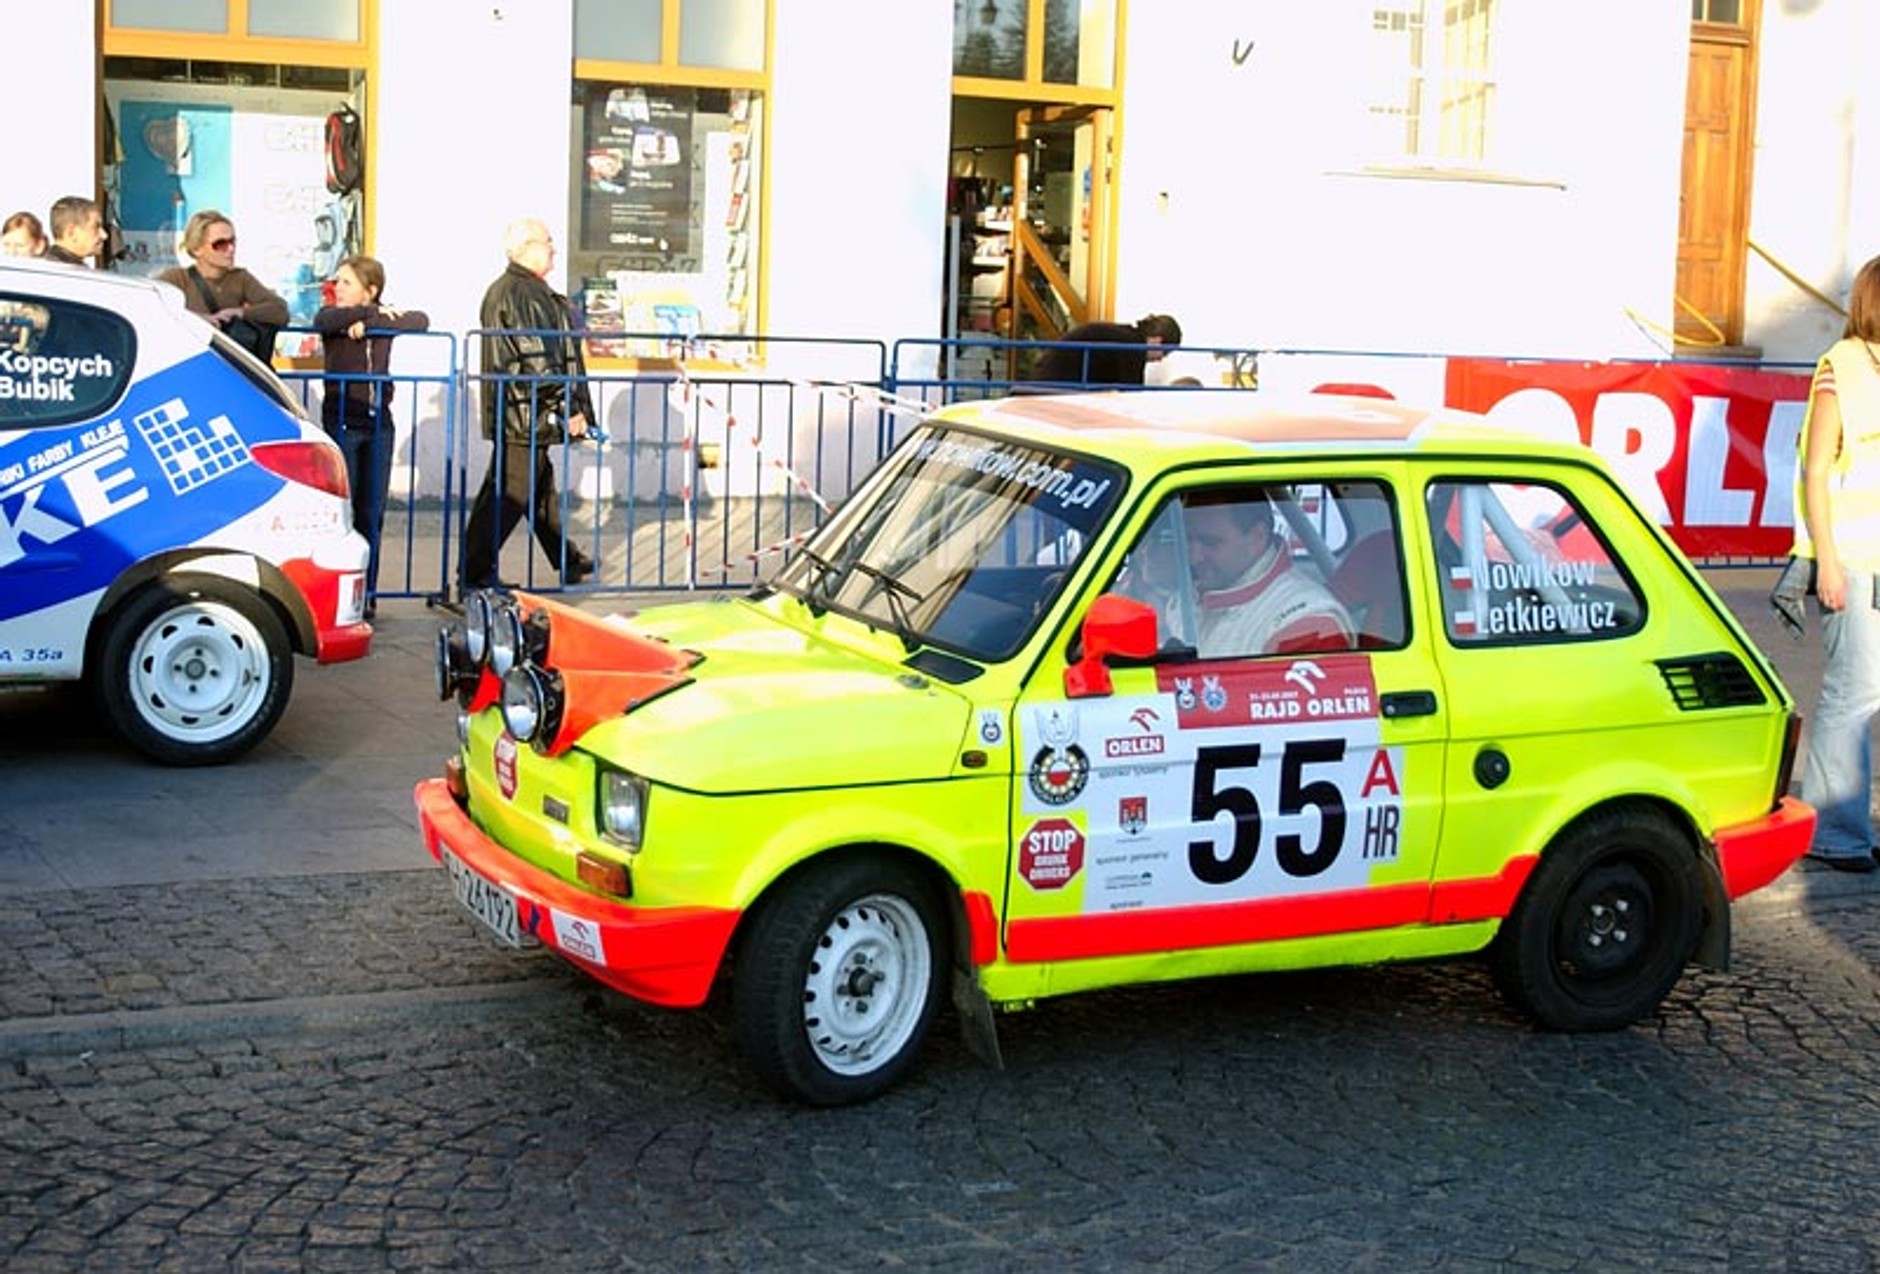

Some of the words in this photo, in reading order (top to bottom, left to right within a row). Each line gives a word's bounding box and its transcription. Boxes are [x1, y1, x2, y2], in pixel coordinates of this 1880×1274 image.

[0, 351, 113, 380] Kopcych
[0, 376, 75, 401] Bubik
[27, 439, 74, 473] FARBY
[79, 418, 126, 450] KLEJE
[1477, 593, 1617, 635] Letkiewicz
[1250, 699, 1301, 719] RAJD
[1307, 695, 1371, 716] ORLEN
[1108, 737, 1161, 755] ORLEN
[1361, 747, 1400, 798] A
[1187, 737, 1347, 885] 55
[1028, 829, 1077, 854] STOP
[1362, 803, 1400, 859] HR
